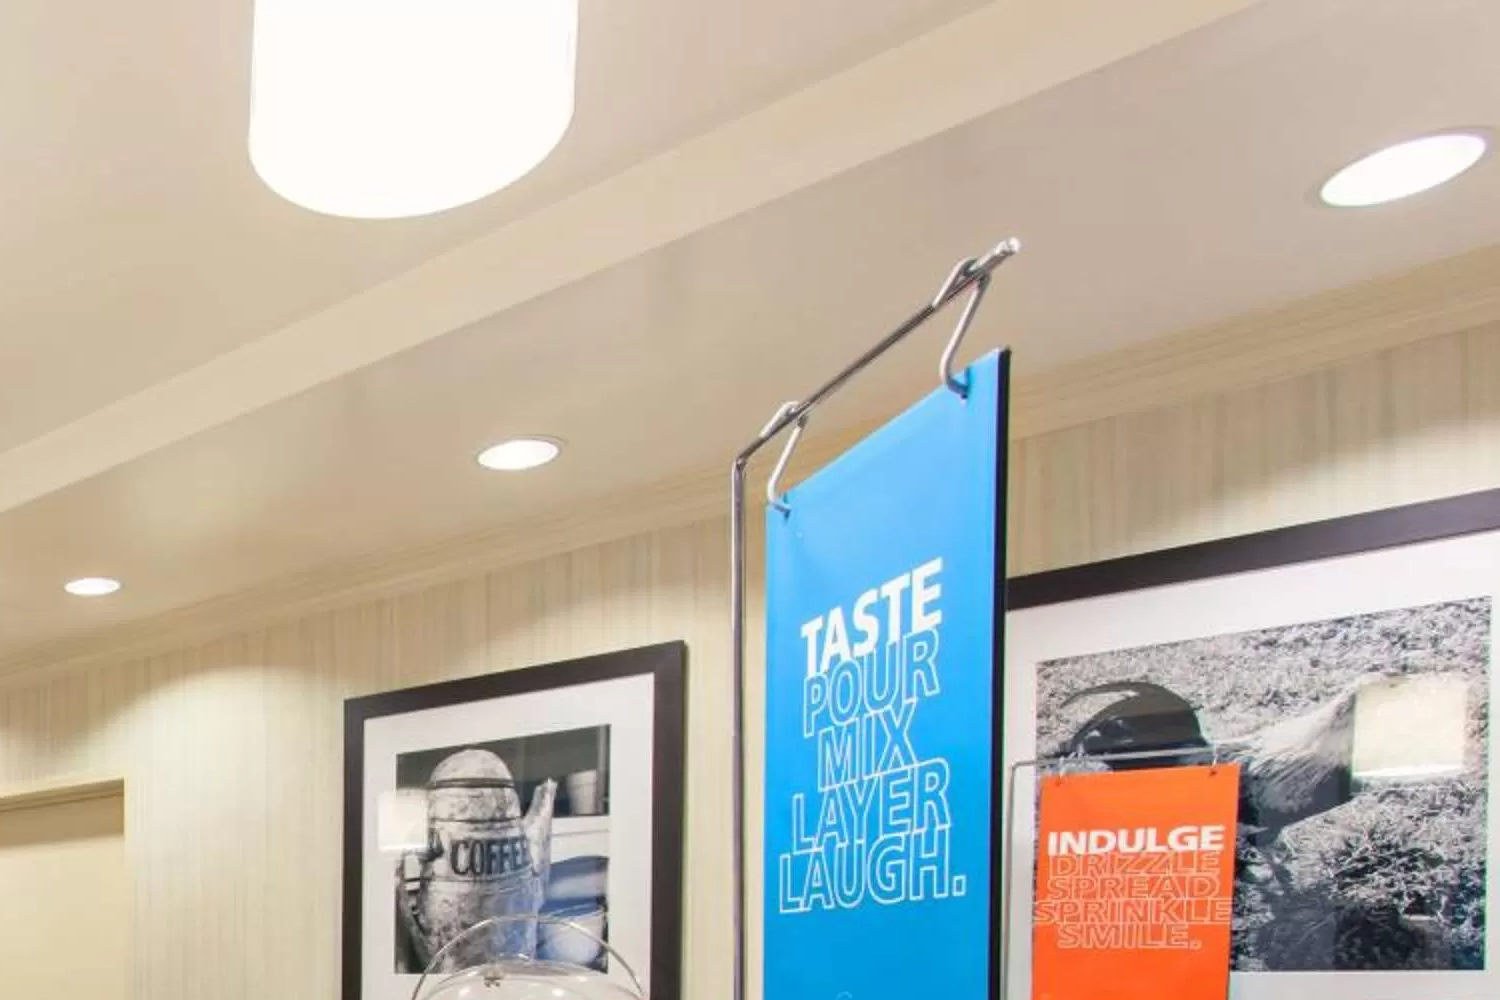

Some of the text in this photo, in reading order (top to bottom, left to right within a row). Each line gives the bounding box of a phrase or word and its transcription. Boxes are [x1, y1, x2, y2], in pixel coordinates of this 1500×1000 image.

[800, 556, 943, 680] TASTE
[804, 627, 941, 738] POUR
[818, 700, 918, 792] MIX
[792, 757, 952, 855] LAYER
[779, 826, 968, 913] LAUGH.
[1047, 824, 1226, 856] INDULGE
[1050, 852, 1221, 878] DRIZZLE
[1033, 898, 1232, 924] SPRINKLE
[1048, 875, 1221, 901] SPREAD
[1057, 922, 1203, 949] SMILE.
